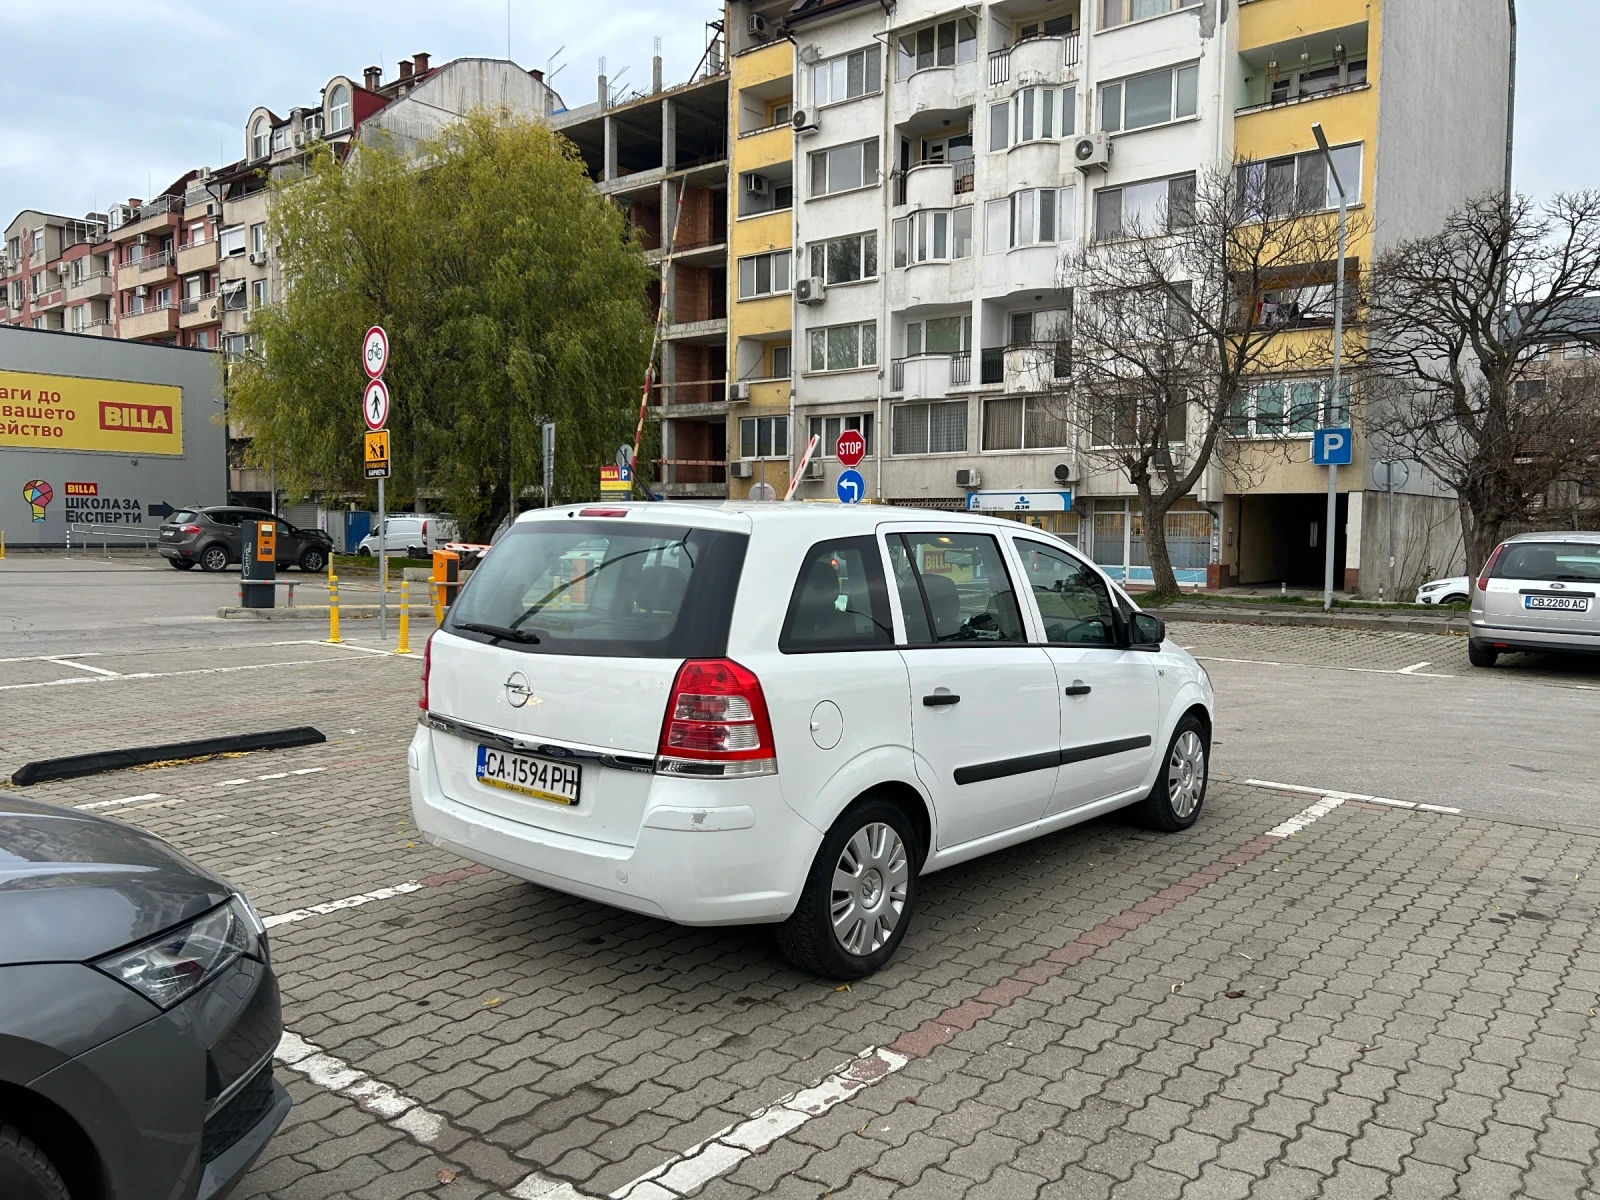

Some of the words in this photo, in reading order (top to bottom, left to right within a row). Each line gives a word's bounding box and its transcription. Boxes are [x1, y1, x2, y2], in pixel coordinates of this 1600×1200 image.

[37, 390, 61, 404] до
[2, 405, 76, 421] вашето
[104, 405, 169, 430] BILLA
[839, 441, 862, 455] STOP
[1323, 433, 1344, 460] P
[601, 470, 619, 479] BILLA
[621, 469, 628, 480] P
[67, 484, 96, 494] BILLA
[65, 497, 121, 510] ШКОЛА
[122, 499, 141, 510] ЗА
[65, 510, 142, 523] ЕКСПЕРТИ
